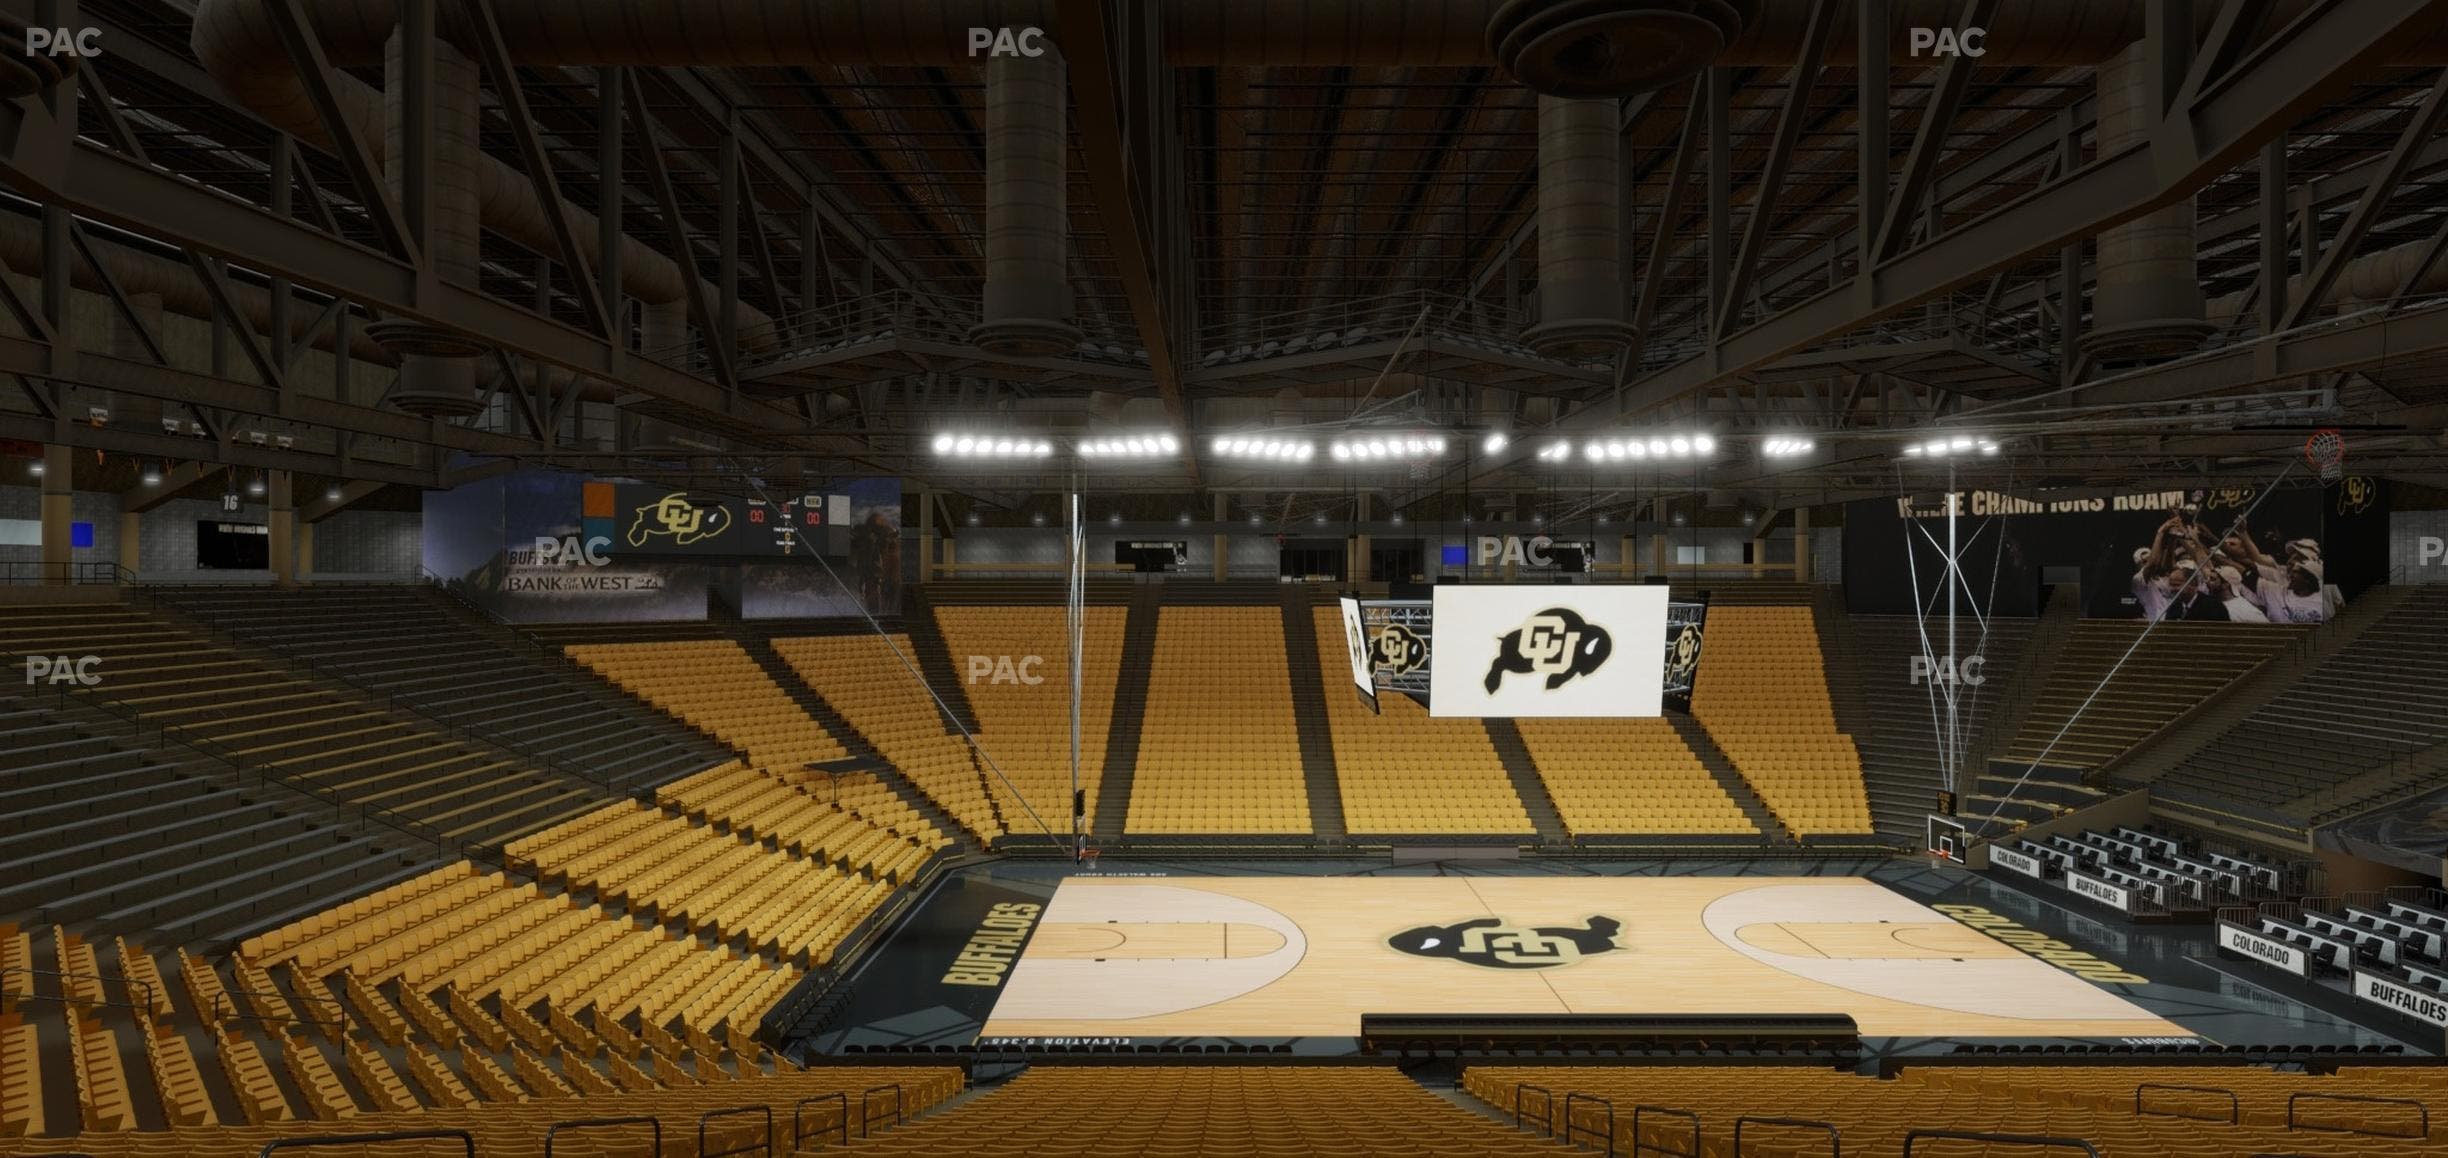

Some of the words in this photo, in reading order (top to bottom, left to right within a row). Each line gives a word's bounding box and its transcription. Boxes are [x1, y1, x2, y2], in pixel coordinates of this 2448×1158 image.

[223, 494, 238, 511] 16
[508, 577, 561, 592] BANK
[581, 576, 633, 591] WEST
[1518, 615, 1581, 675] CU
[1996, 851, 2031, 873] COLORADO
[2075, 877, 2119, 904] BUFFALOES
[939, 902, 1042, 987] BUFFALOES
[1931, 903, 2151, 985] COLORADO
[2232, 933, 2290, 965] COLORADO
[2370, 981, 2448, 1022] BUFFALOES
[1043, 1037, 1131, 1046] ELEVATION
